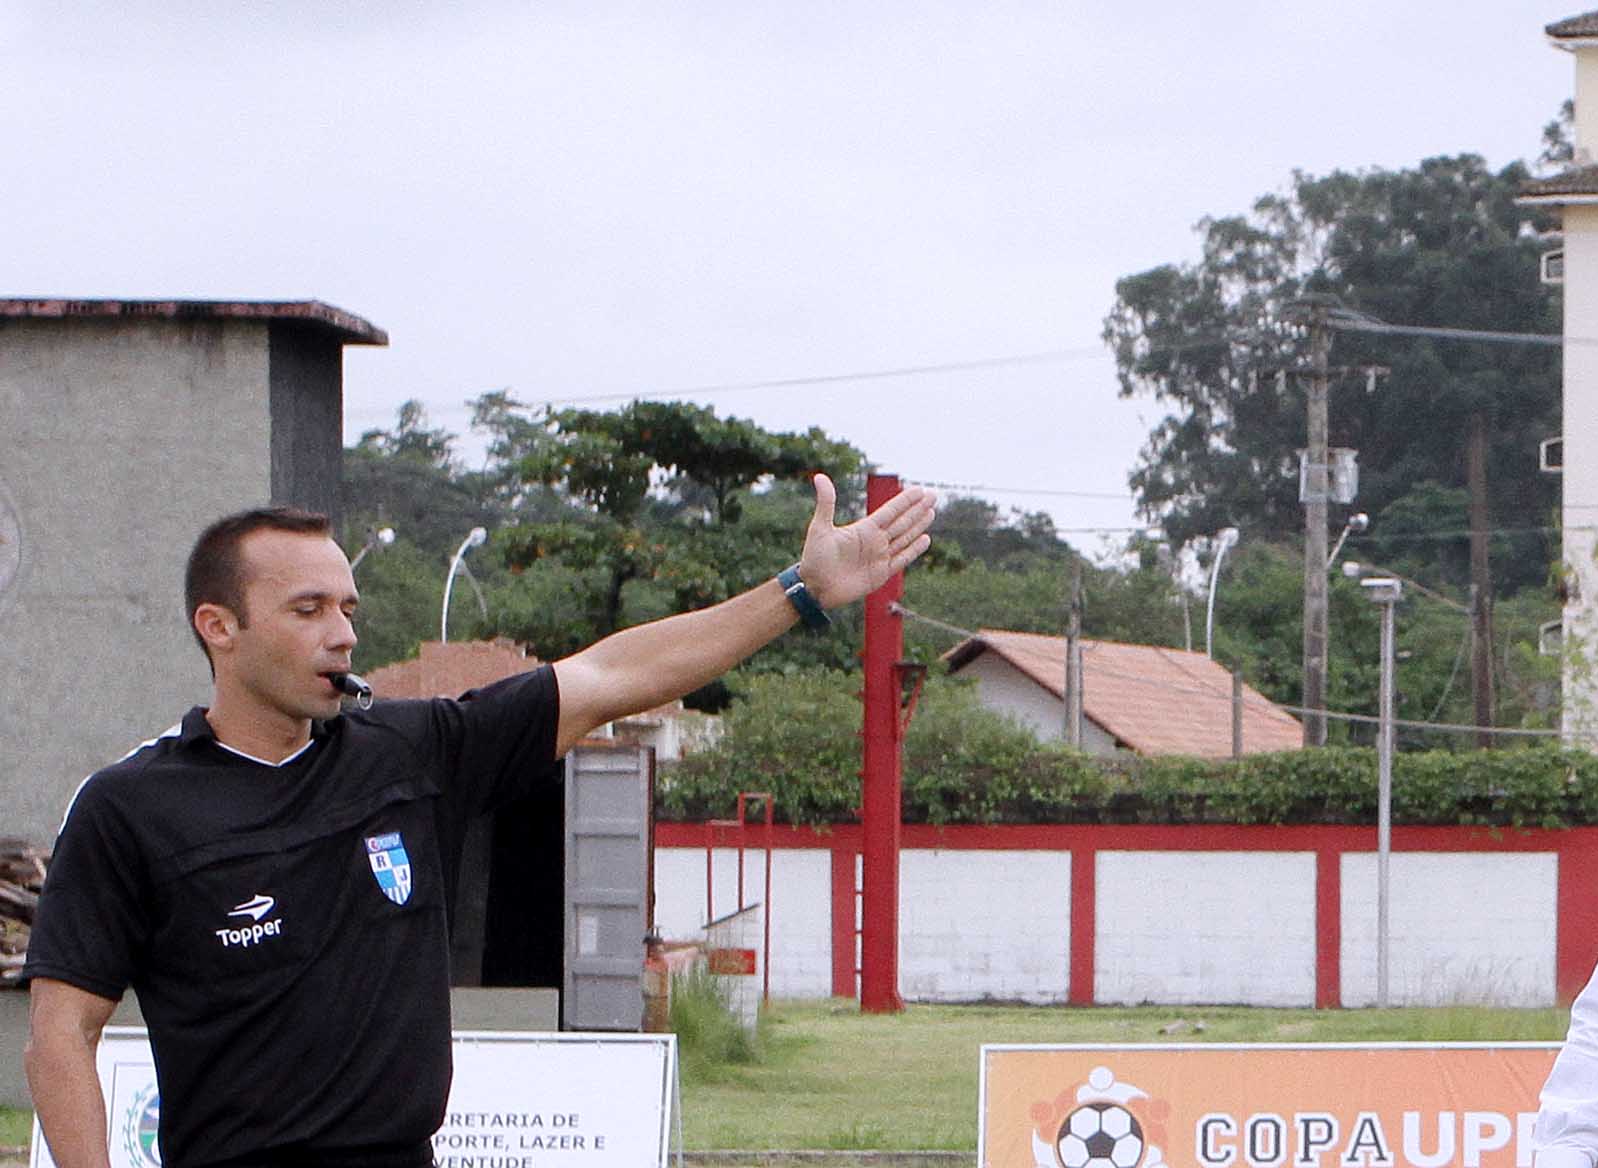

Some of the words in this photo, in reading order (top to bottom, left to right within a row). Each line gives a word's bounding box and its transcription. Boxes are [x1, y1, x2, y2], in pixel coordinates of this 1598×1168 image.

[215, 918, 283, 948] Topper
[552, 1113, 580, 1128] DE
[519, 1135, 586, 1150] LAZER
[594, 1135, 606, 1150] E
